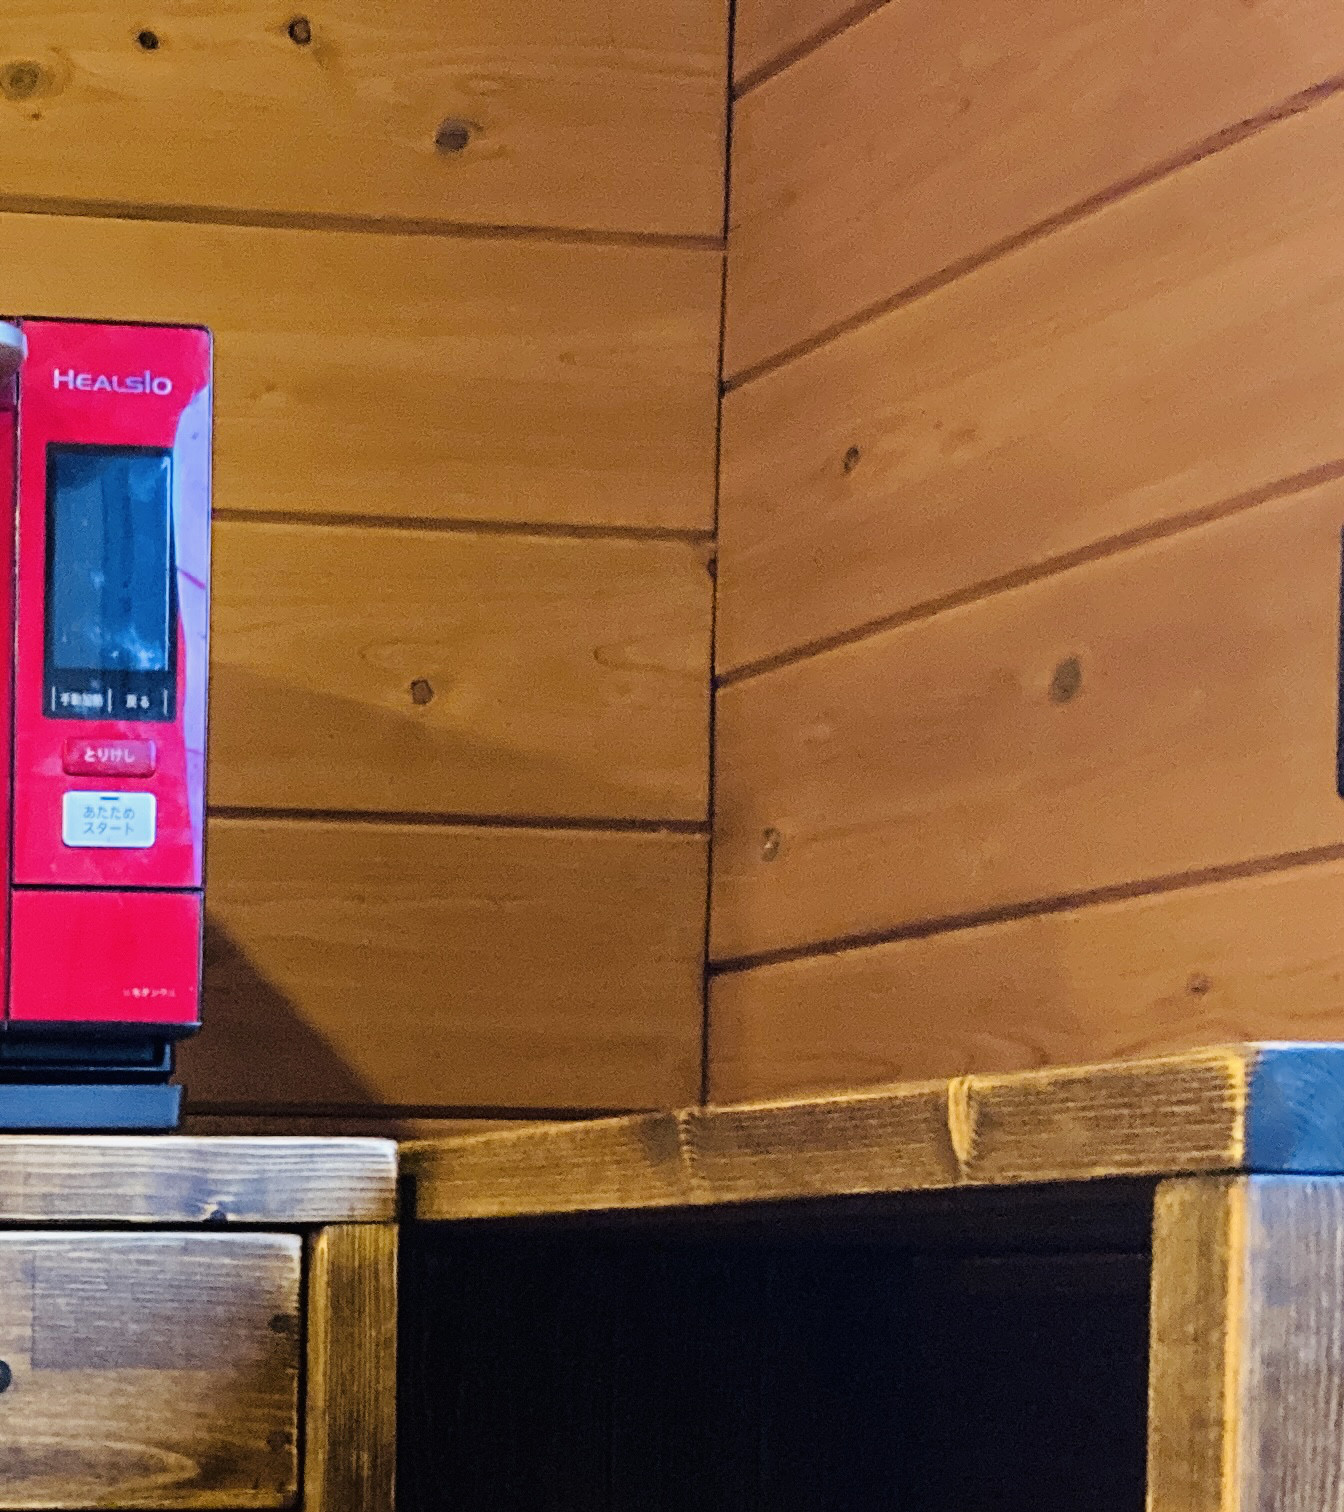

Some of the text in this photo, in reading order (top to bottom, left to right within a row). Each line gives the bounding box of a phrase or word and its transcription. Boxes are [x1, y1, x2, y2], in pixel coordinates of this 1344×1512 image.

[84, 746, 136, 763] とりけし
[83, 805, 135, 820] あたため
[83, 822, 135, 835] スタート
